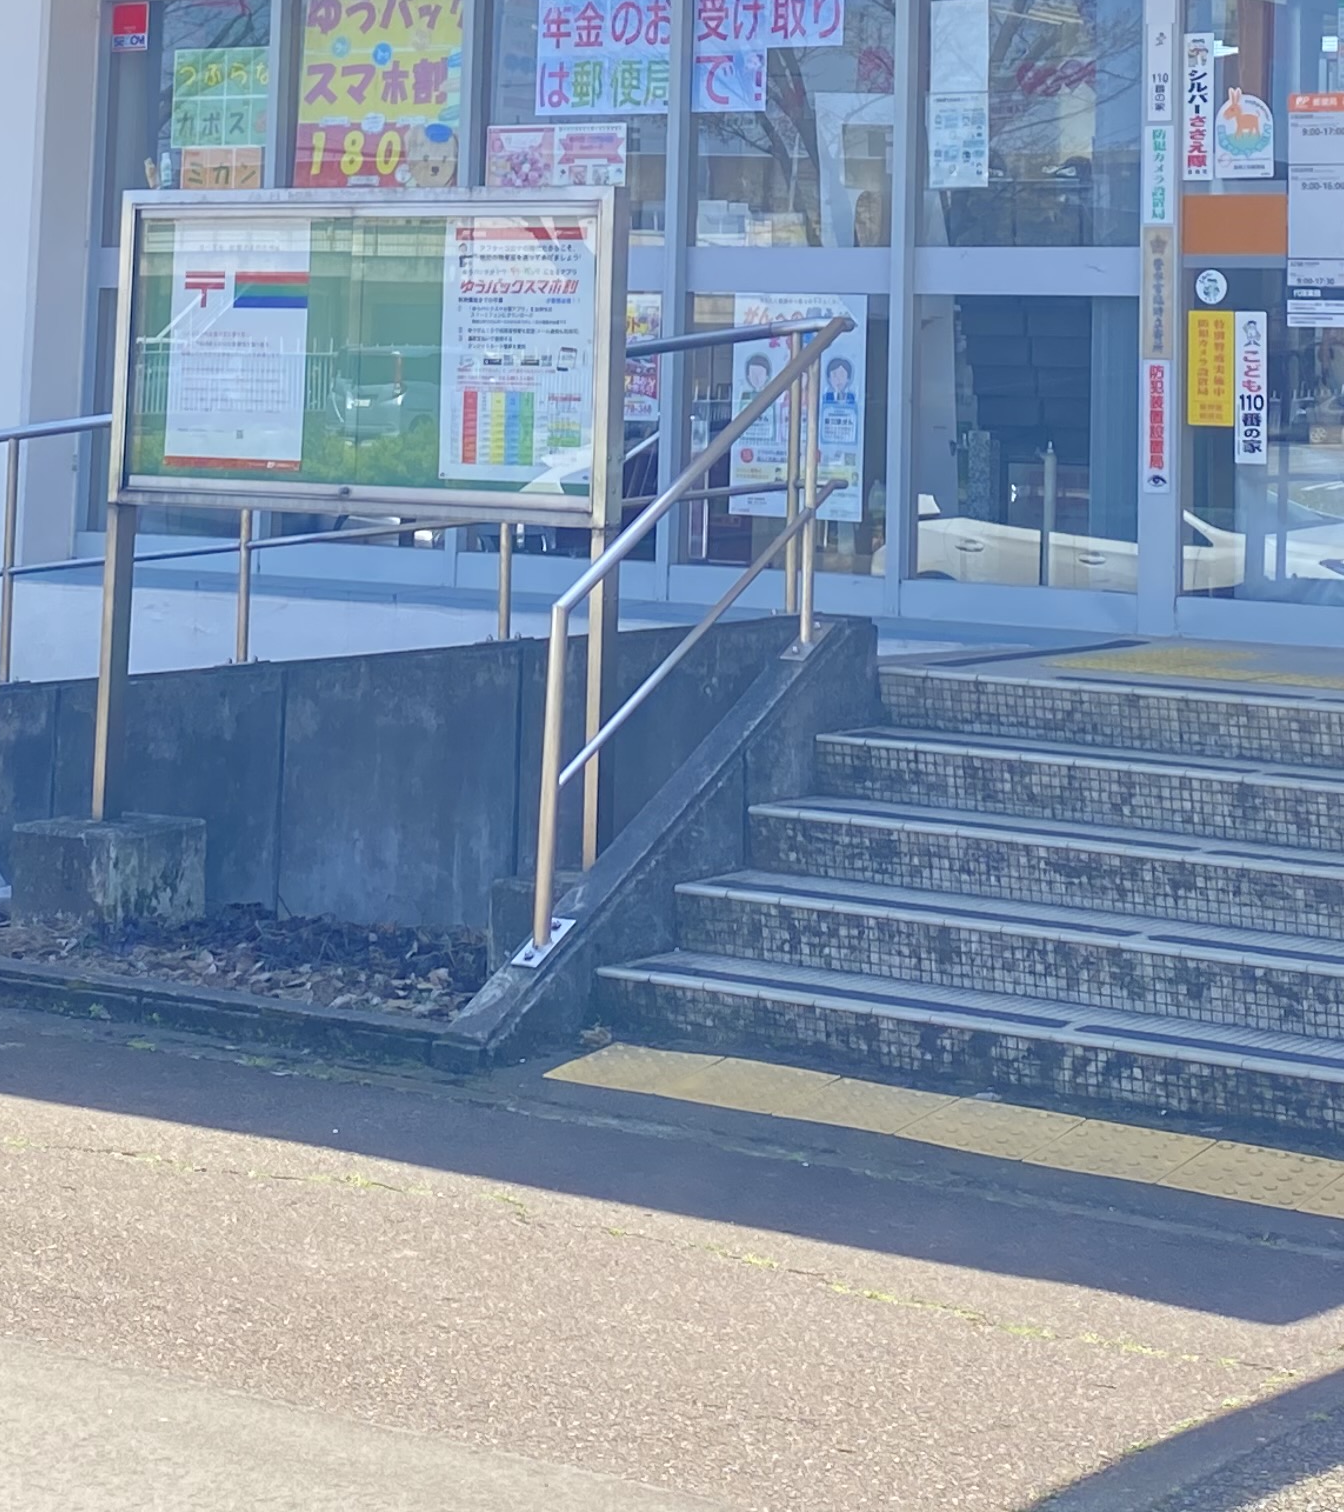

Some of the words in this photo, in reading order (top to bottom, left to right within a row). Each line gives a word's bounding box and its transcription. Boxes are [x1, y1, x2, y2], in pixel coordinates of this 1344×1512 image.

[113, 34, 145, 48] SEOM
[179, 61, 269, 86] つぶらな
[304, 57, 448, 105] スマホ割
[176, 111, 245, 136] カボス
[311, 130, 401, 175] 180
[187, 162, 256, 185] ミカン
[460, 278, 580, 294] ゆうパックスマホ割
[1239, 350, 1265, 454] こども110番の家
